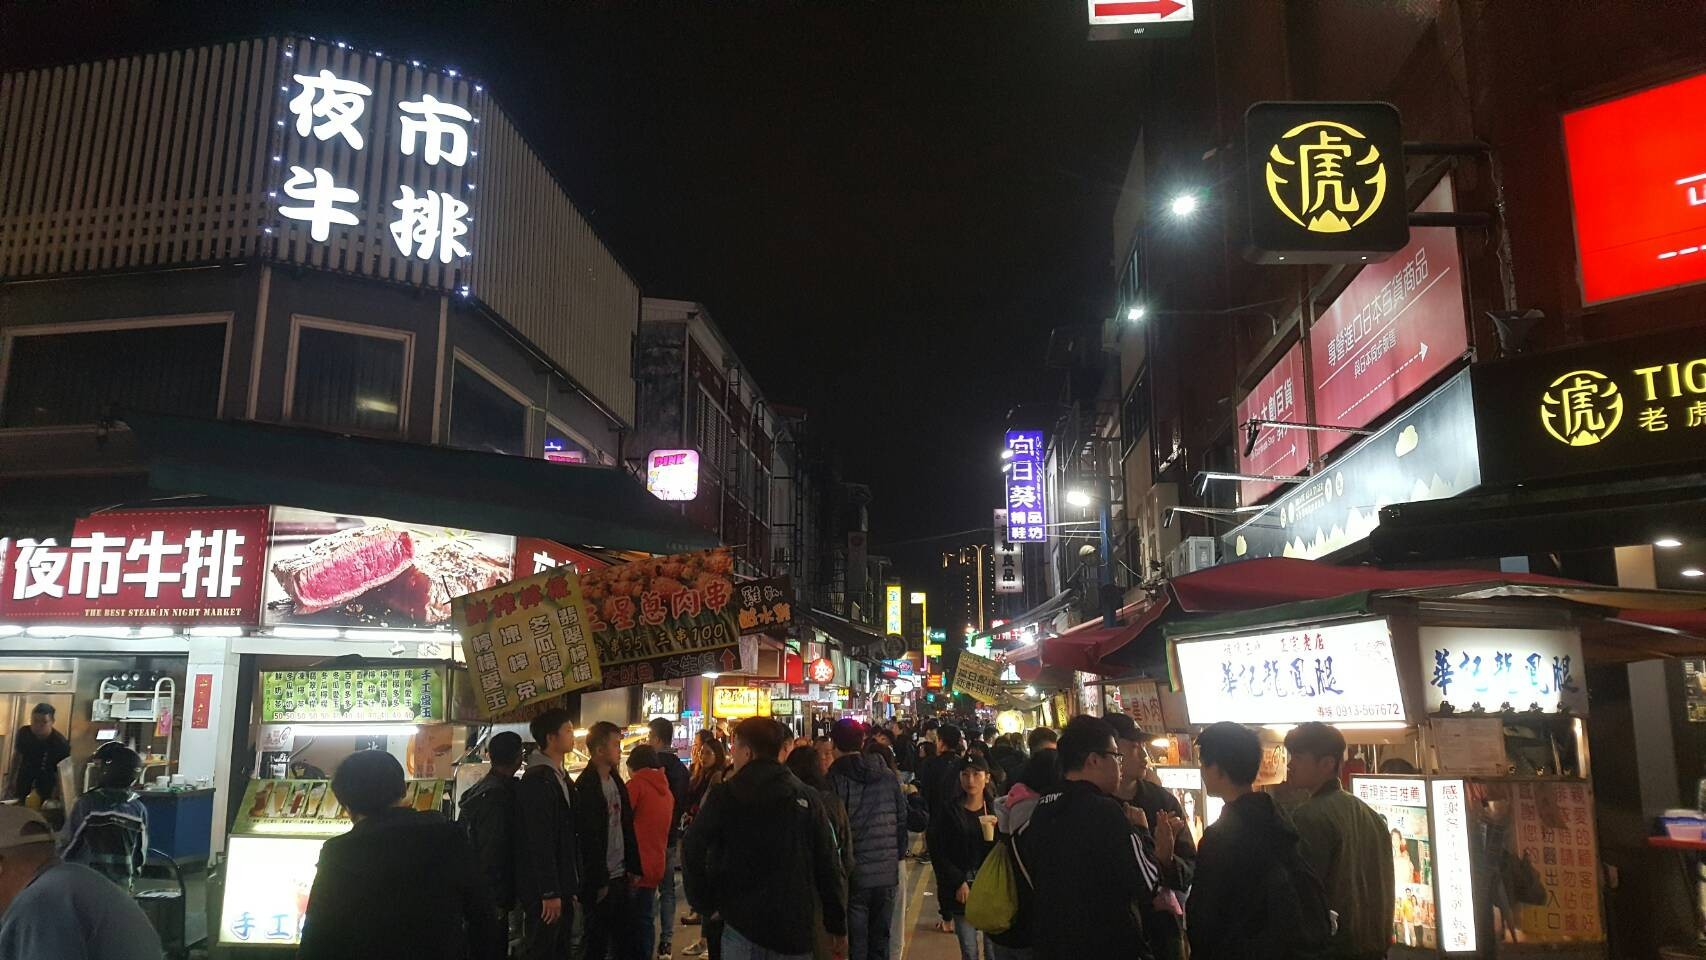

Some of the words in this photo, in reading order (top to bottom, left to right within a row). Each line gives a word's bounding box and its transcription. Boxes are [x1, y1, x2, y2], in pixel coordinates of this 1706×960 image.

[289, 69, 473, 167] 夜市
[278, 166, 472, 264] 牛排
[1328, 247, 1428, 366] 專營進口日本百貨商品
[654, 453, 687, 468] PINK
[1009, 434, 1036, 508] 向日葵
[1010, 511, 1043, 524] 精品
[1011, 526, 1043, 540] 鞋坊
[13, 529, 246, 600] 夜市牛排
[84, 608, 102, 617] THE
[103, 608, 126, 617] BEST
[128, 608, 157, 617] STEAK
[159, 608, 170, 617] IN
[171, 608, 201, 617] NIGHT
[203, 607, 242, 616] MARKET
[274, 711, 283, 720] 50
